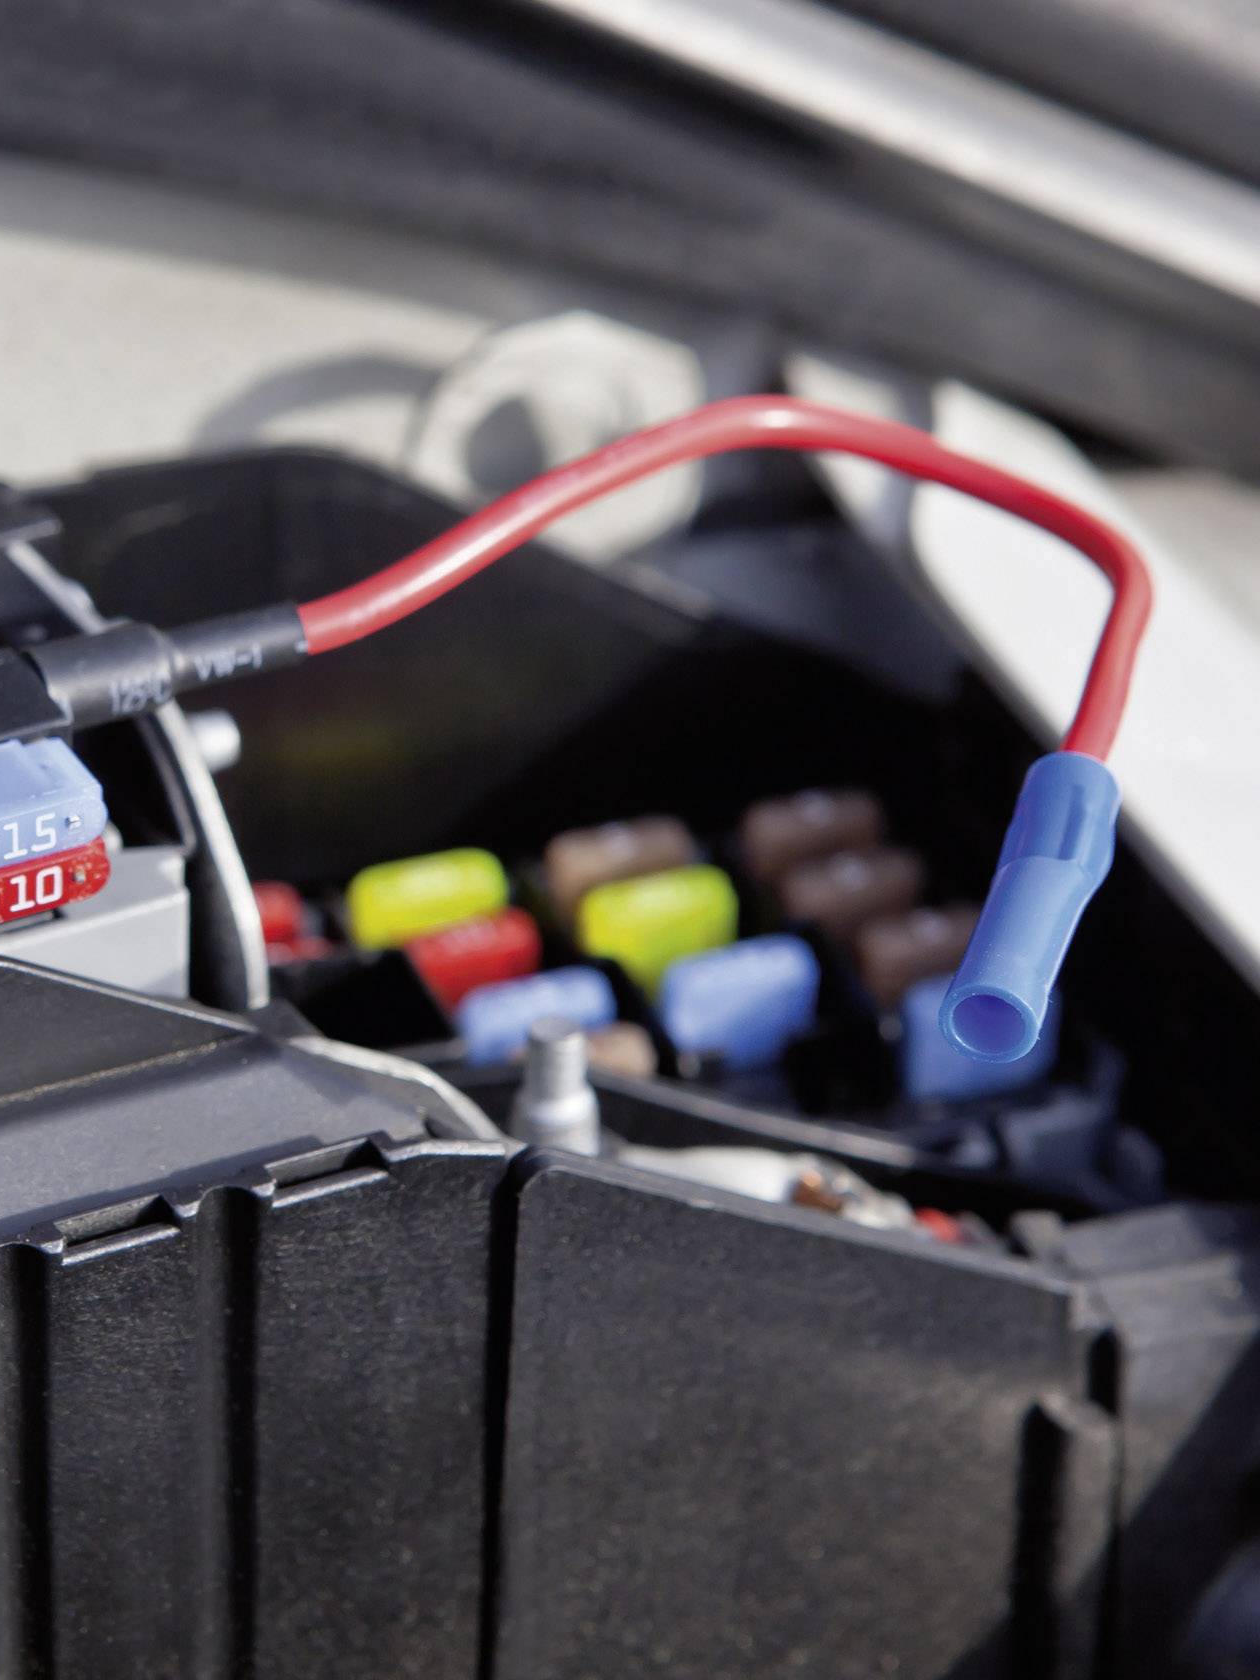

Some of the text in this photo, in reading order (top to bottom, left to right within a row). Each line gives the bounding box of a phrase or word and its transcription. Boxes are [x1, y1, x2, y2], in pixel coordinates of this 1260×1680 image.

[194, 642, 263, 682] VW-1
[2, 812, 59, 860] 15
[9, 865, 65, 912] 10
